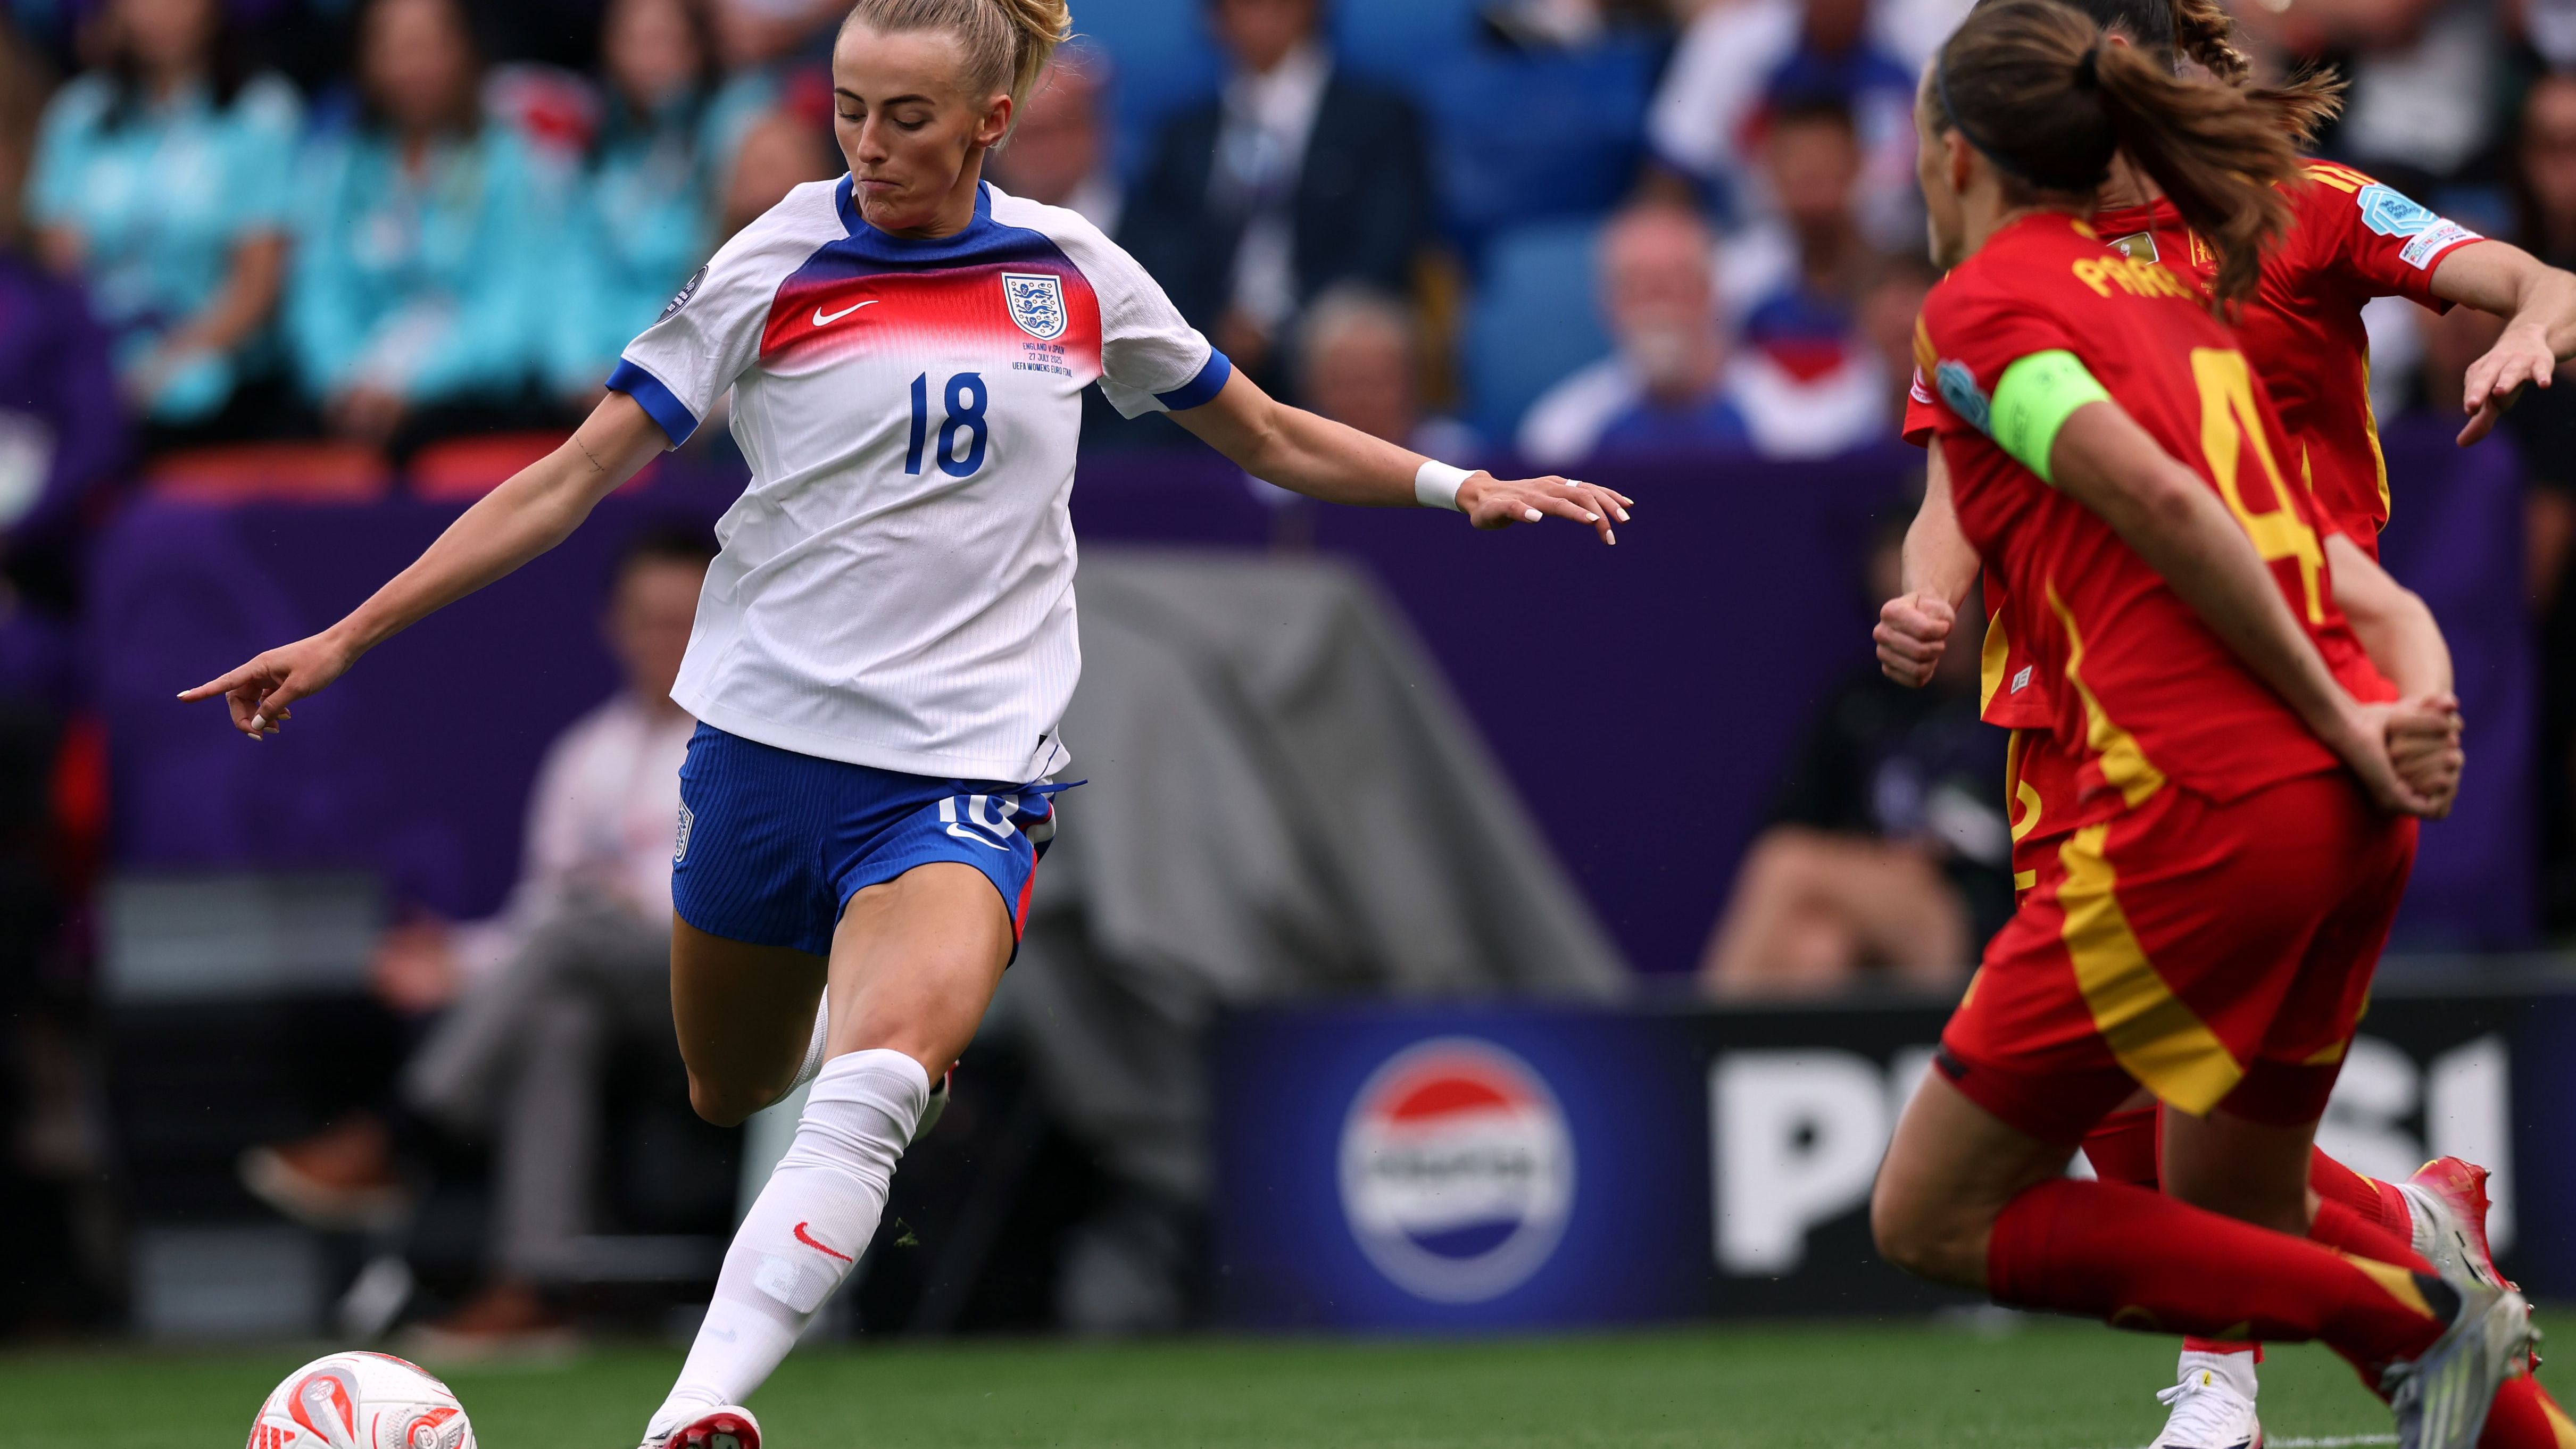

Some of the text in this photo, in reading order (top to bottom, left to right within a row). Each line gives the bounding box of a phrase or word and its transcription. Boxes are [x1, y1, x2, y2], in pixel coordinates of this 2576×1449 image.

[1023, 343, 1046, 351] ENGLAND
[1052, 345, 1065, 355] SPAIN
[1038, 353, 1049, 362] JULY
[1051, 355, 1062, 364] 2025
[1012, 362, 1073, 378] UEFA WOMENS EURO FINAL
[905, 371, 988, 478] 18
[2189, 347, 2324, 624] 4
